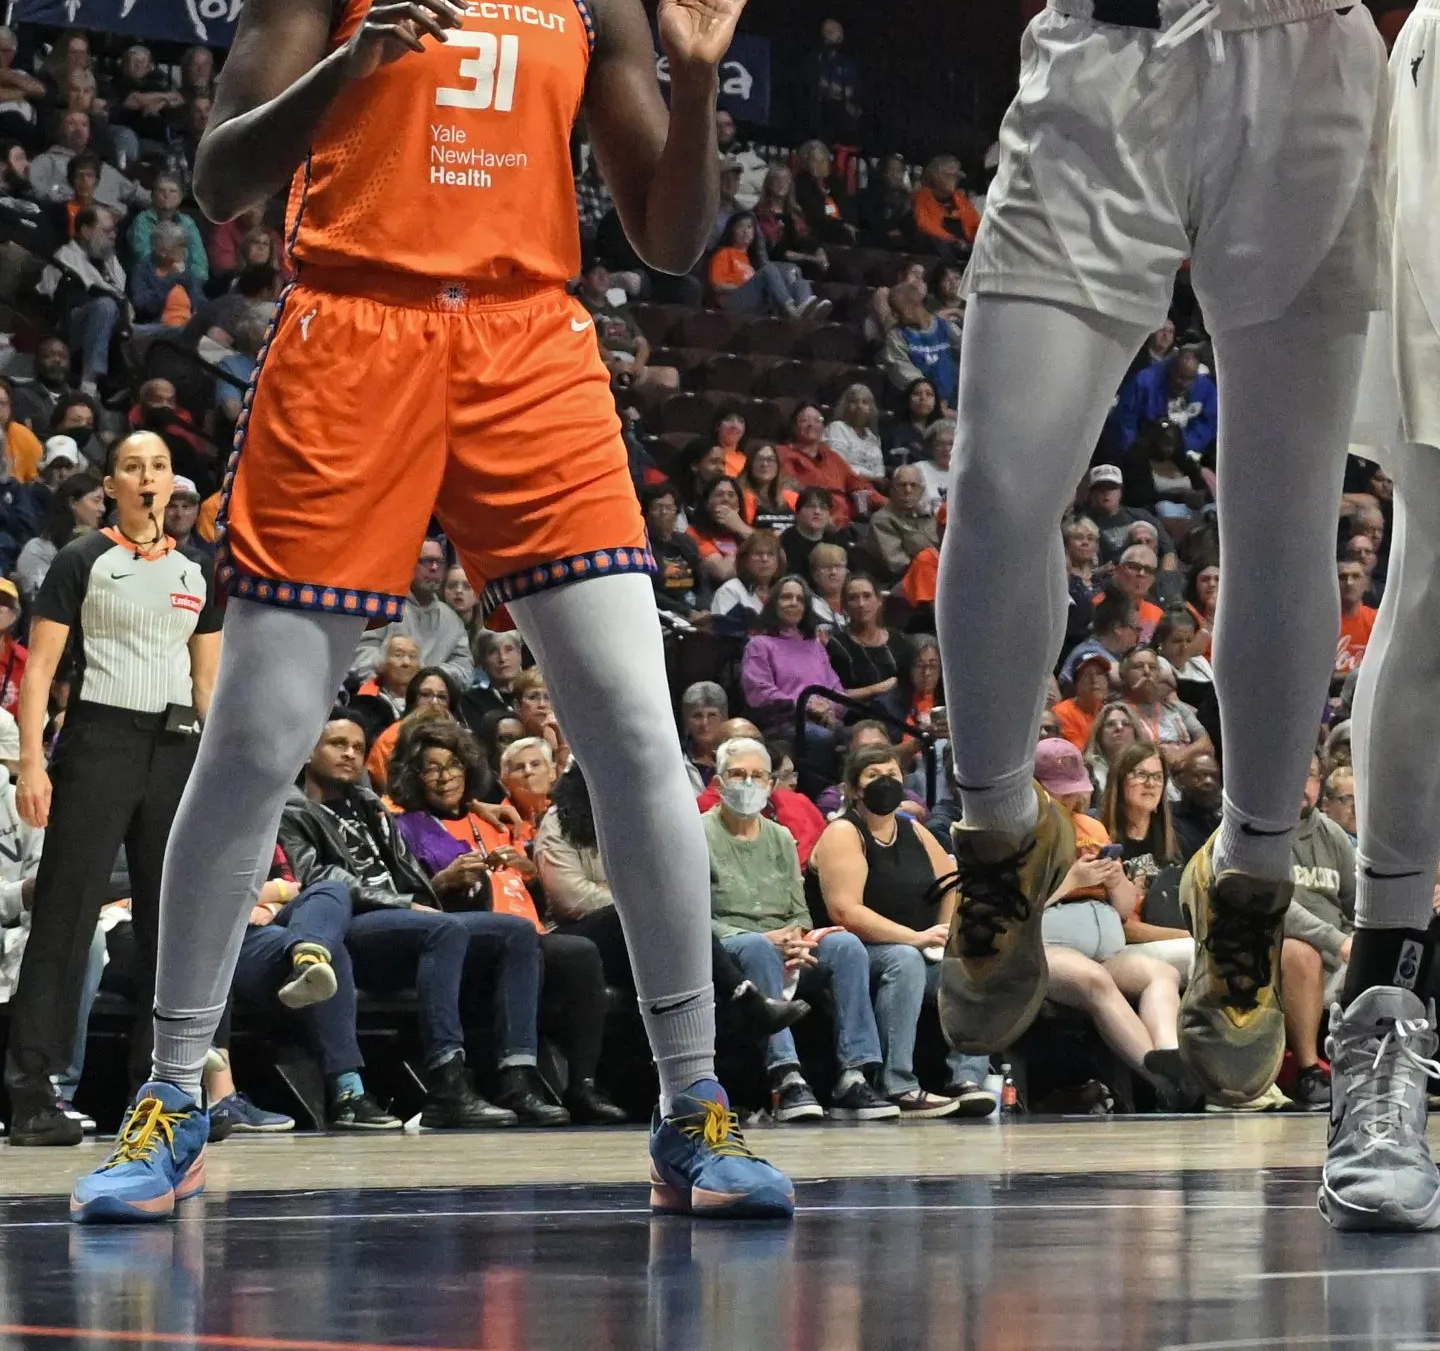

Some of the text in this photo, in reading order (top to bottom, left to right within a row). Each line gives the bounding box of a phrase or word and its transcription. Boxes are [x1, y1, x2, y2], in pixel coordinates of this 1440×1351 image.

[438, 0, 565, 33] ECTICUT
[435, 29, 518, 111] 31
[431, 124, 466, 143] Yale
[431, 145, 527, 167] NewHaven
[431, 166, 491, 187] Health
